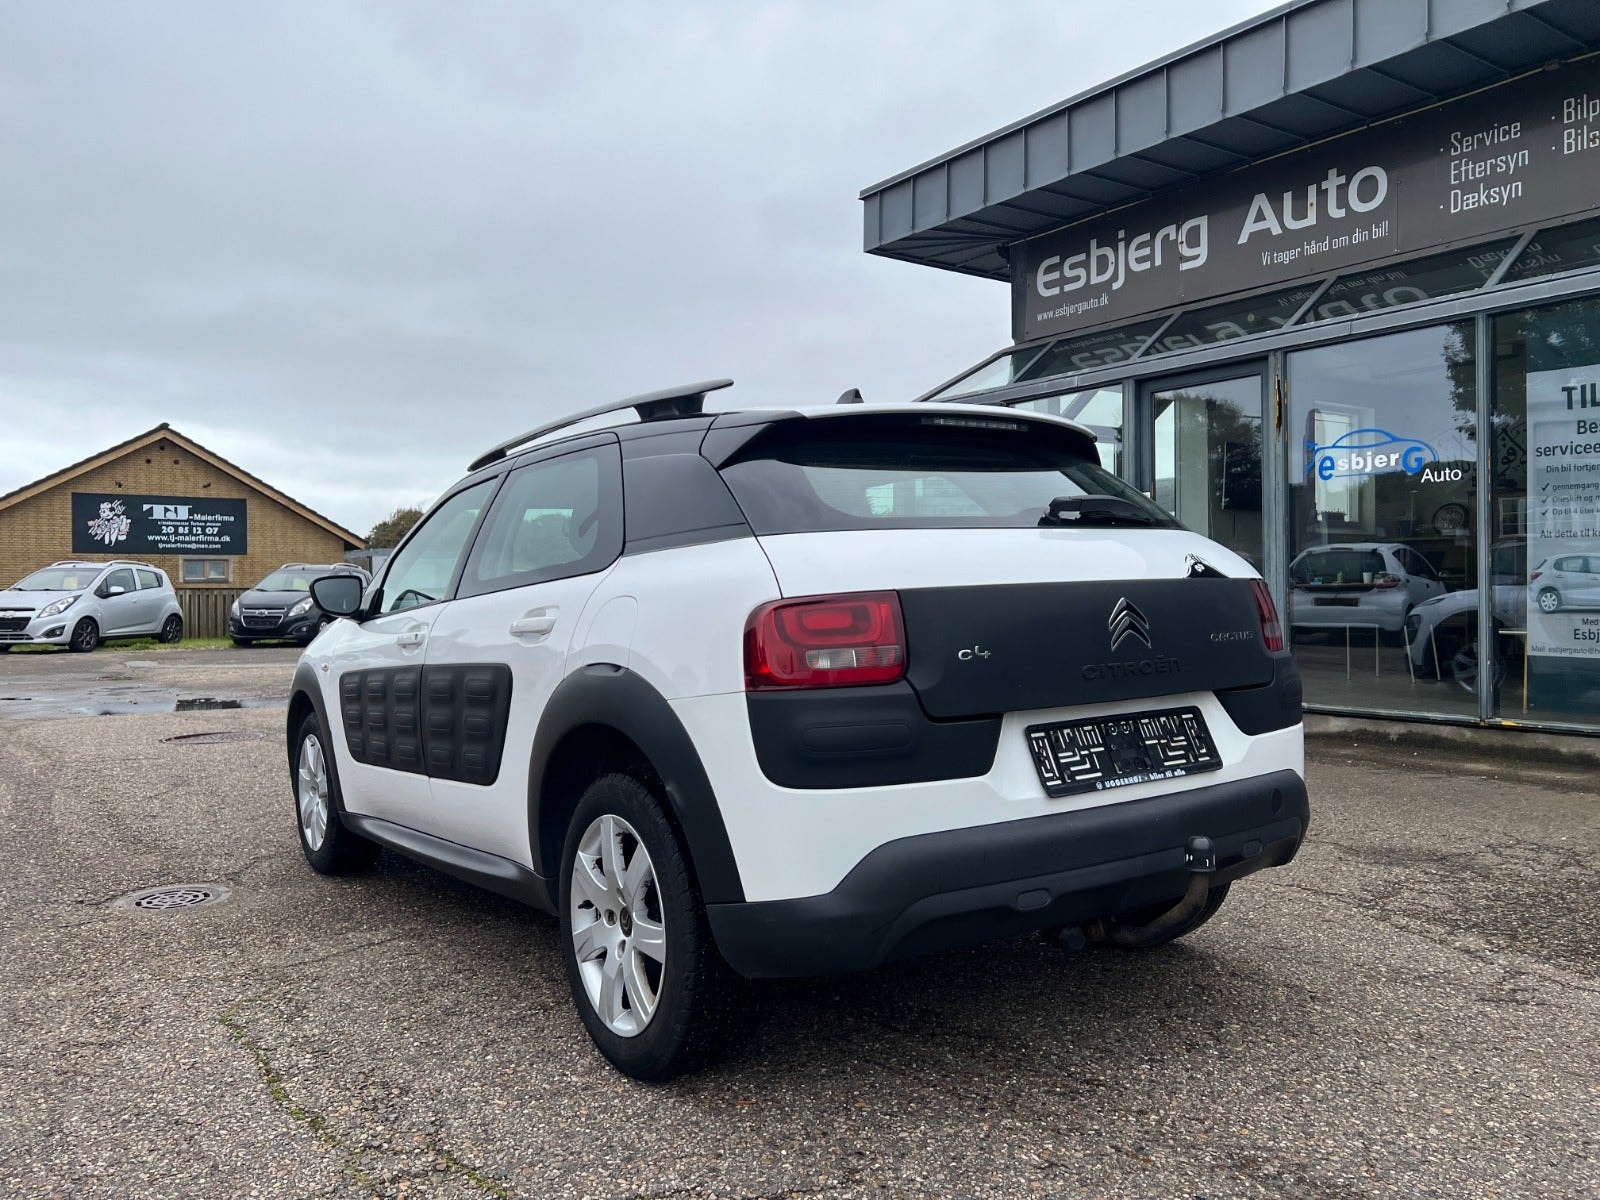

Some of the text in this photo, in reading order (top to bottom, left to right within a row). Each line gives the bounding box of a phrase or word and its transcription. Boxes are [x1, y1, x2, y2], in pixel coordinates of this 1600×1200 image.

[1451, 122, 1521, 156] Service
[1450, 150, 1529, 185] Eftersyn
[1450, 181, 1522, 213] Dæksyn
[1036, 165, 1388, 298] Esbjerg Auto
[1261, 220, 1389, 266] Vi tager hånd om din bil!
[1036, 292, 1109, 322] www.esbjergauto.dk
[1576, 420, 1600, 435] Be
[1420, 466, 1463, 483] Auto
[1546, 465, 1559, 473] Din
[1560, 464, 1571, 472] bil
[147, 534, 231, 542] www.tj-malerfirma.dk
[161, 526, 175, 534] 20
[178, 526, 190, 534] 85
[205, 527, 219, 535] 07
[1554, 529, 1578, 538] dette
